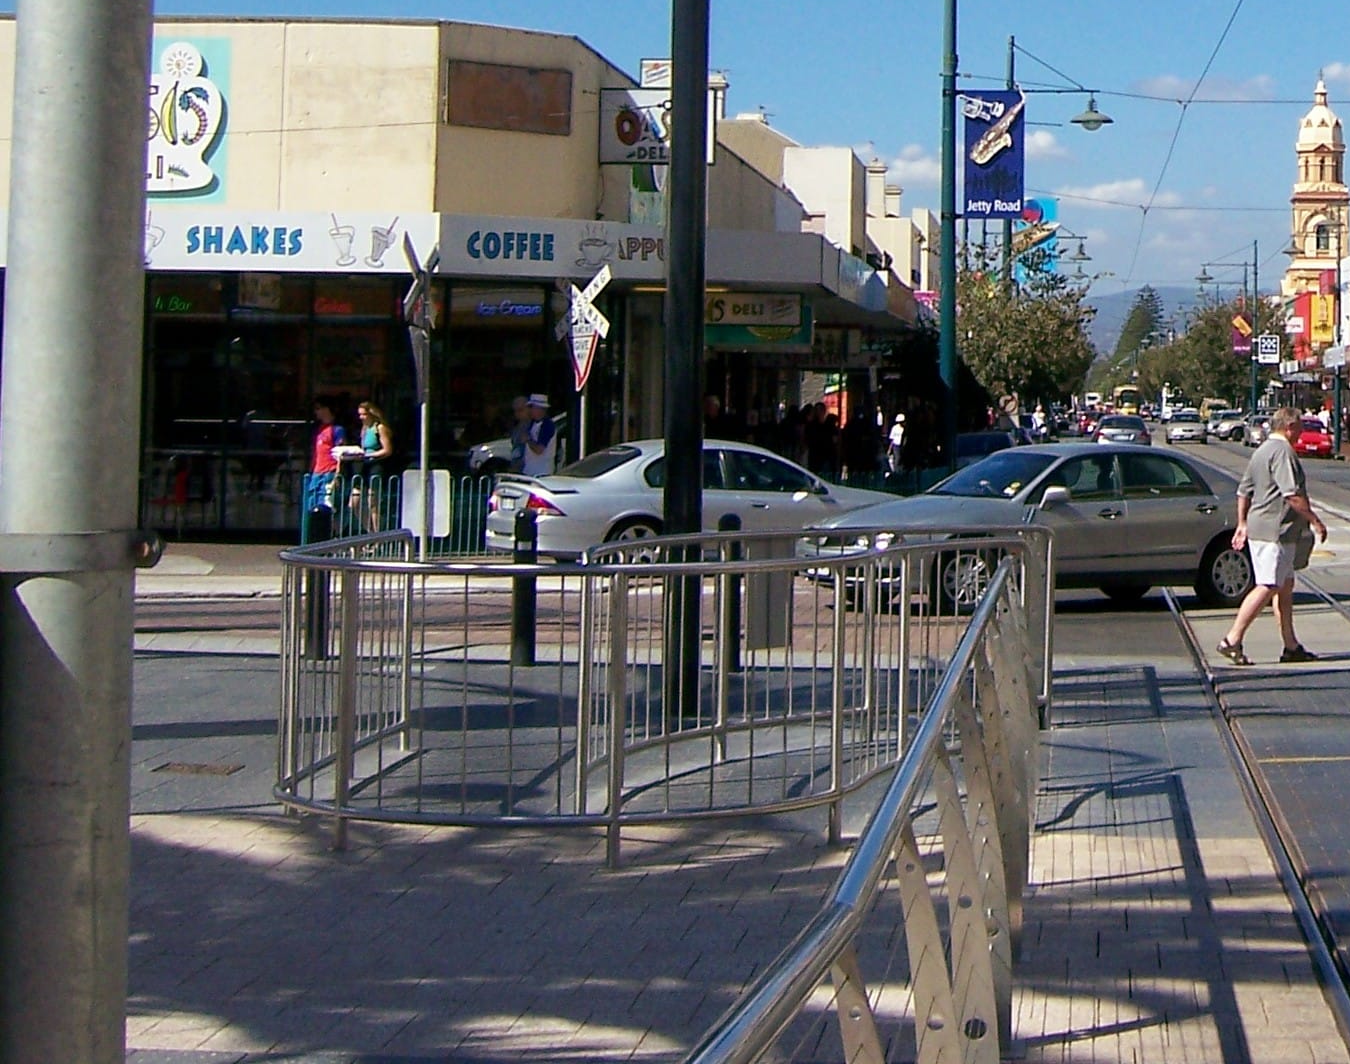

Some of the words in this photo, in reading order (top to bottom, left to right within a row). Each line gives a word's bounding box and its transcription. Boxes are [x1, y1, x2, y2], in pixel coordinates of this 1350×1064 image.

[967, 199, 992, 214] Jetty
[994, 199, 1021, 212] Road
[187, 225, 303, 256] SHAKES
[466, 230, 554, 261] COFFEE
[732, 303, 764, 316] DELI
